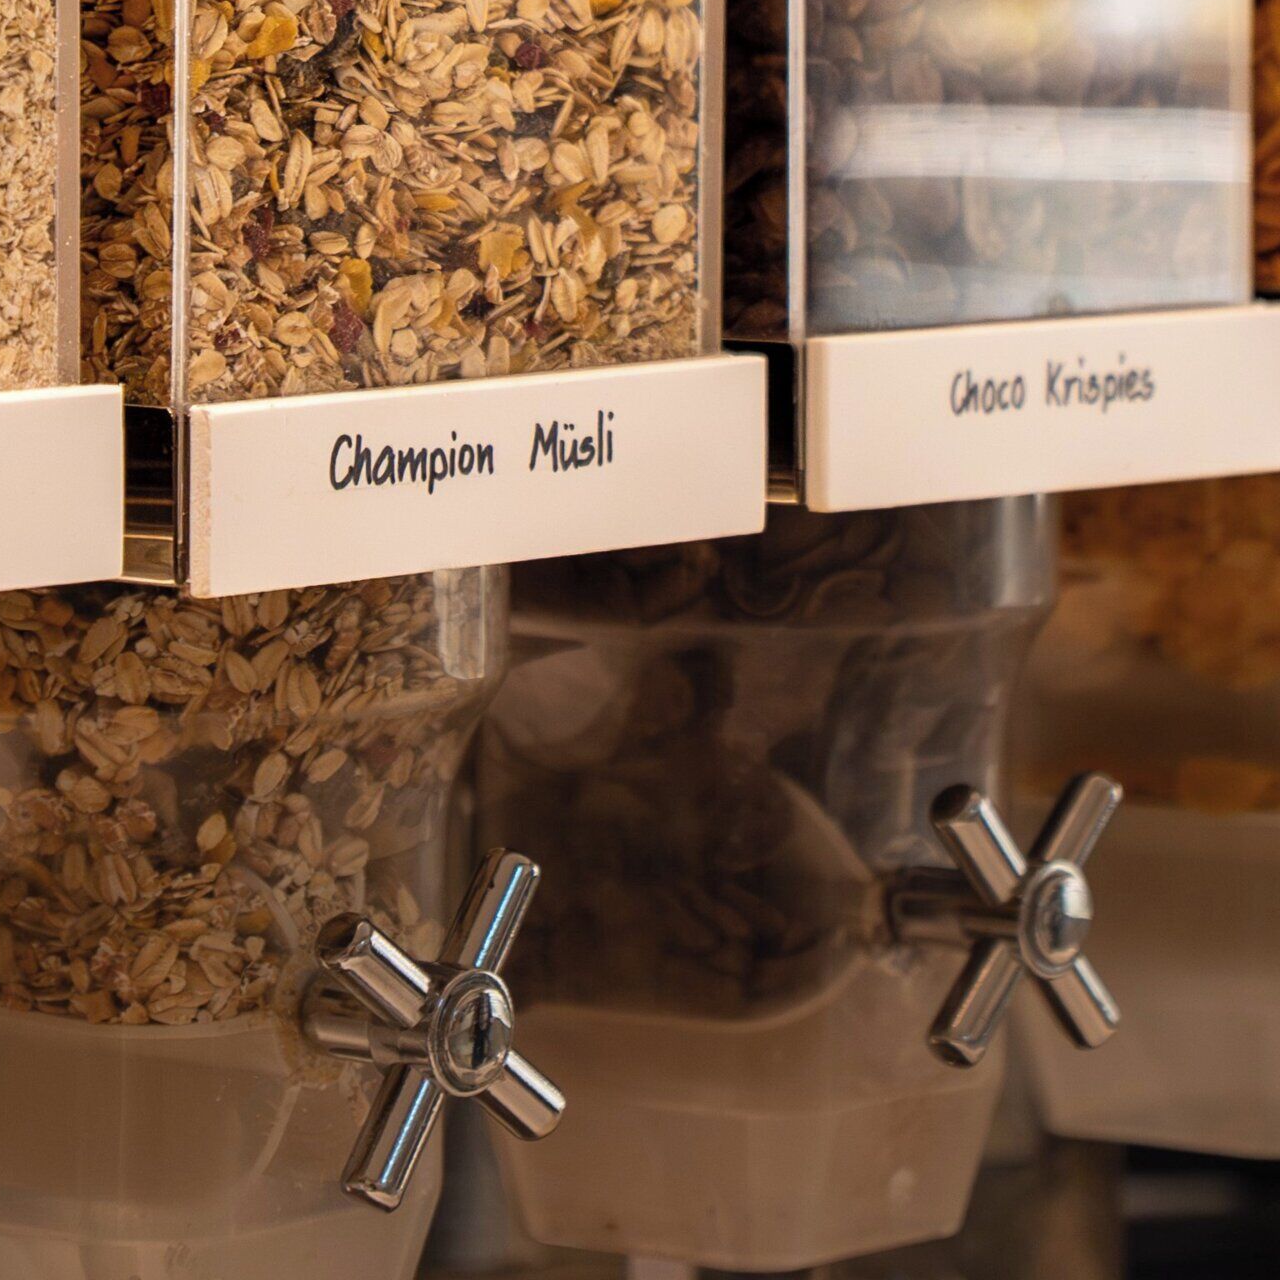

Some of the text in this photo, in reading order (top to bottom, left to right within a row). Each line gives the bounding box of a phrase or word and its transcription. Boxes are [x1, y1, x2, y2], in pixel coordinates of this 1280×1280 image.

[949, 356, 1156, 417] Choco Krispies
[328, 409, 615, 496] Champion Müsli
